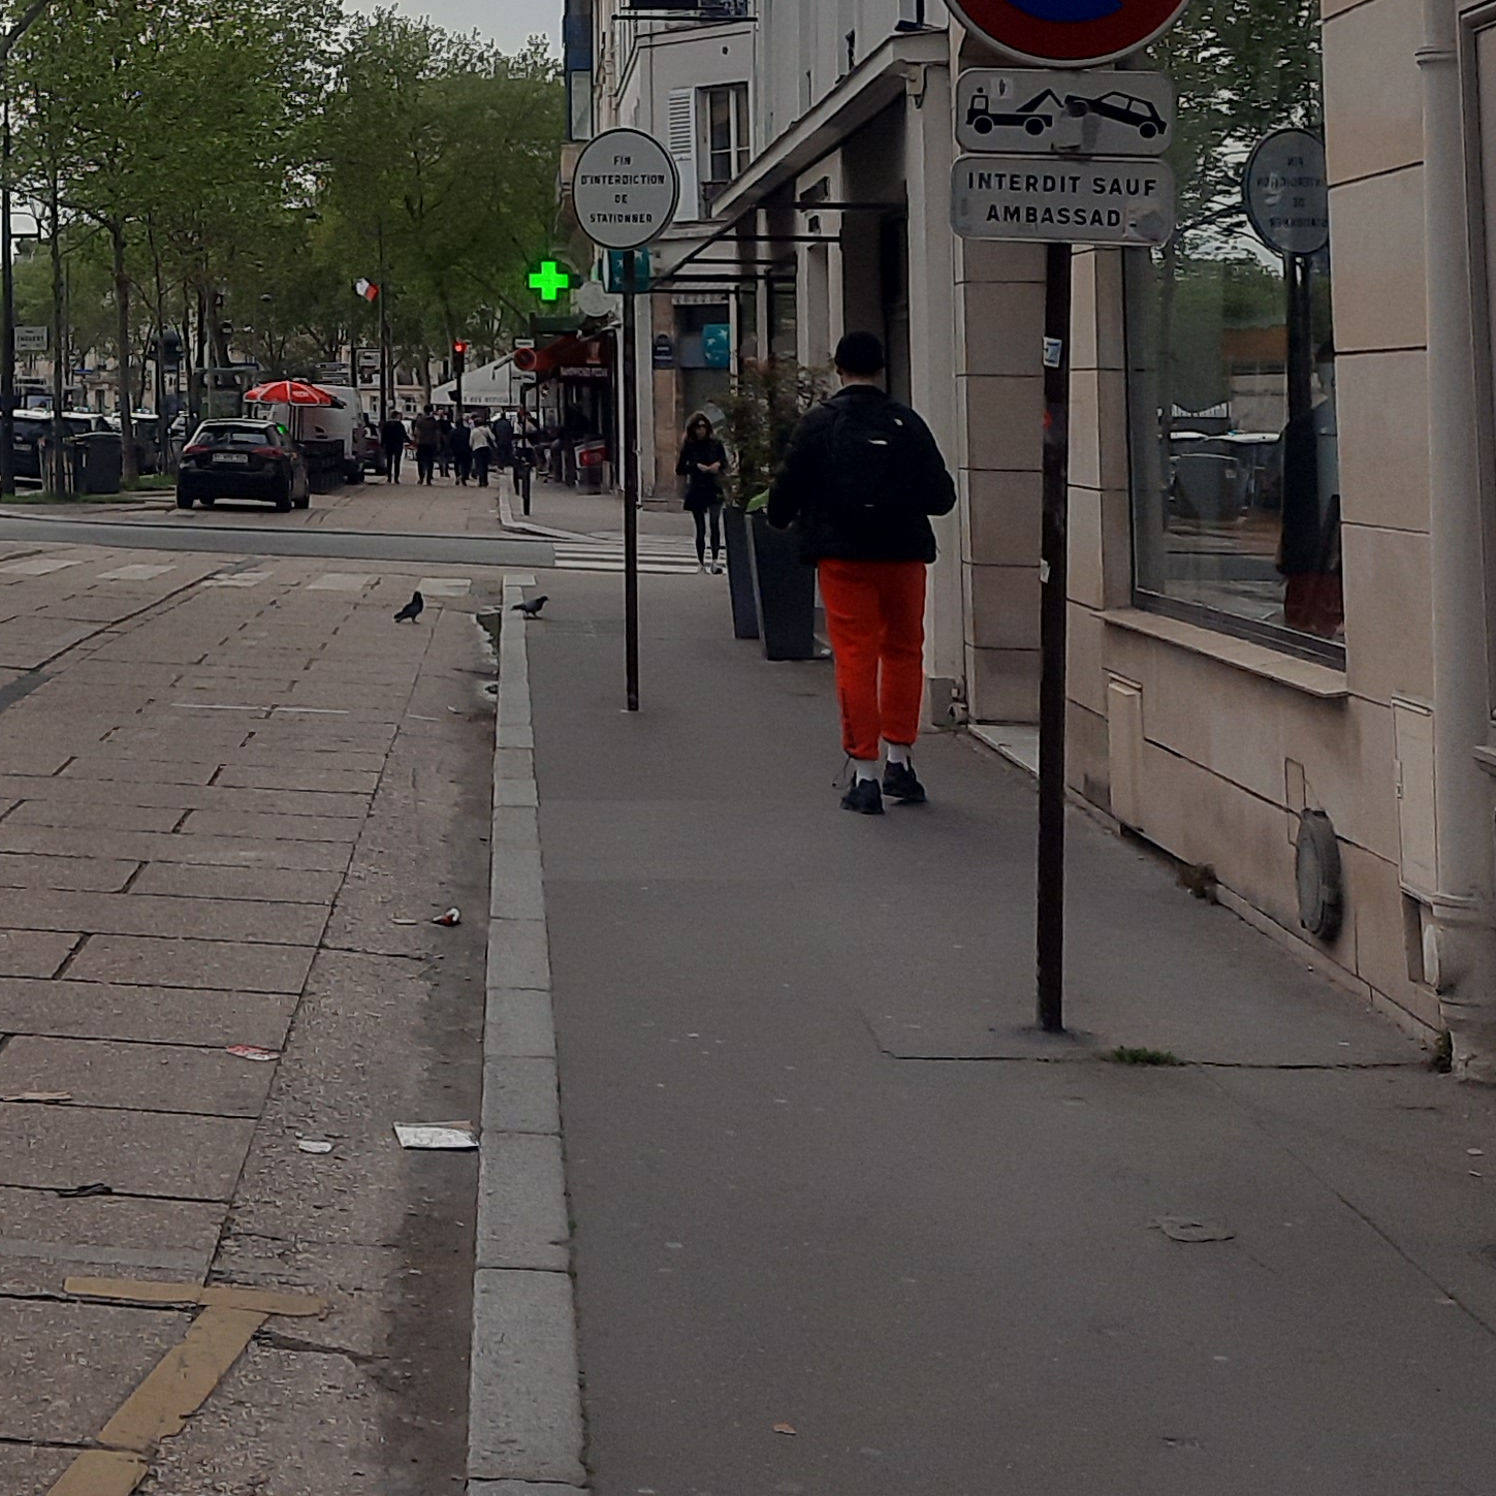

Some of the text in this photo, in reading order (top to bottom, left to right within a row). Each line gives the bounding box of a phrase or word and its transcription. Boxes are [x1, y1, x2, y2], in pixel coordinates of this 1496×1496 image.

[613, 156, 631, 165] FIN
[580, 175, 665, 185] D'INTERDICTION
[968, 172, 1158, 197] INTERDIT SAUF
[614, 194, 628, 204] DE
[590, 213, 653, 223] STATIONNER
[986, 204, 1138, 229] AMBASSAD
